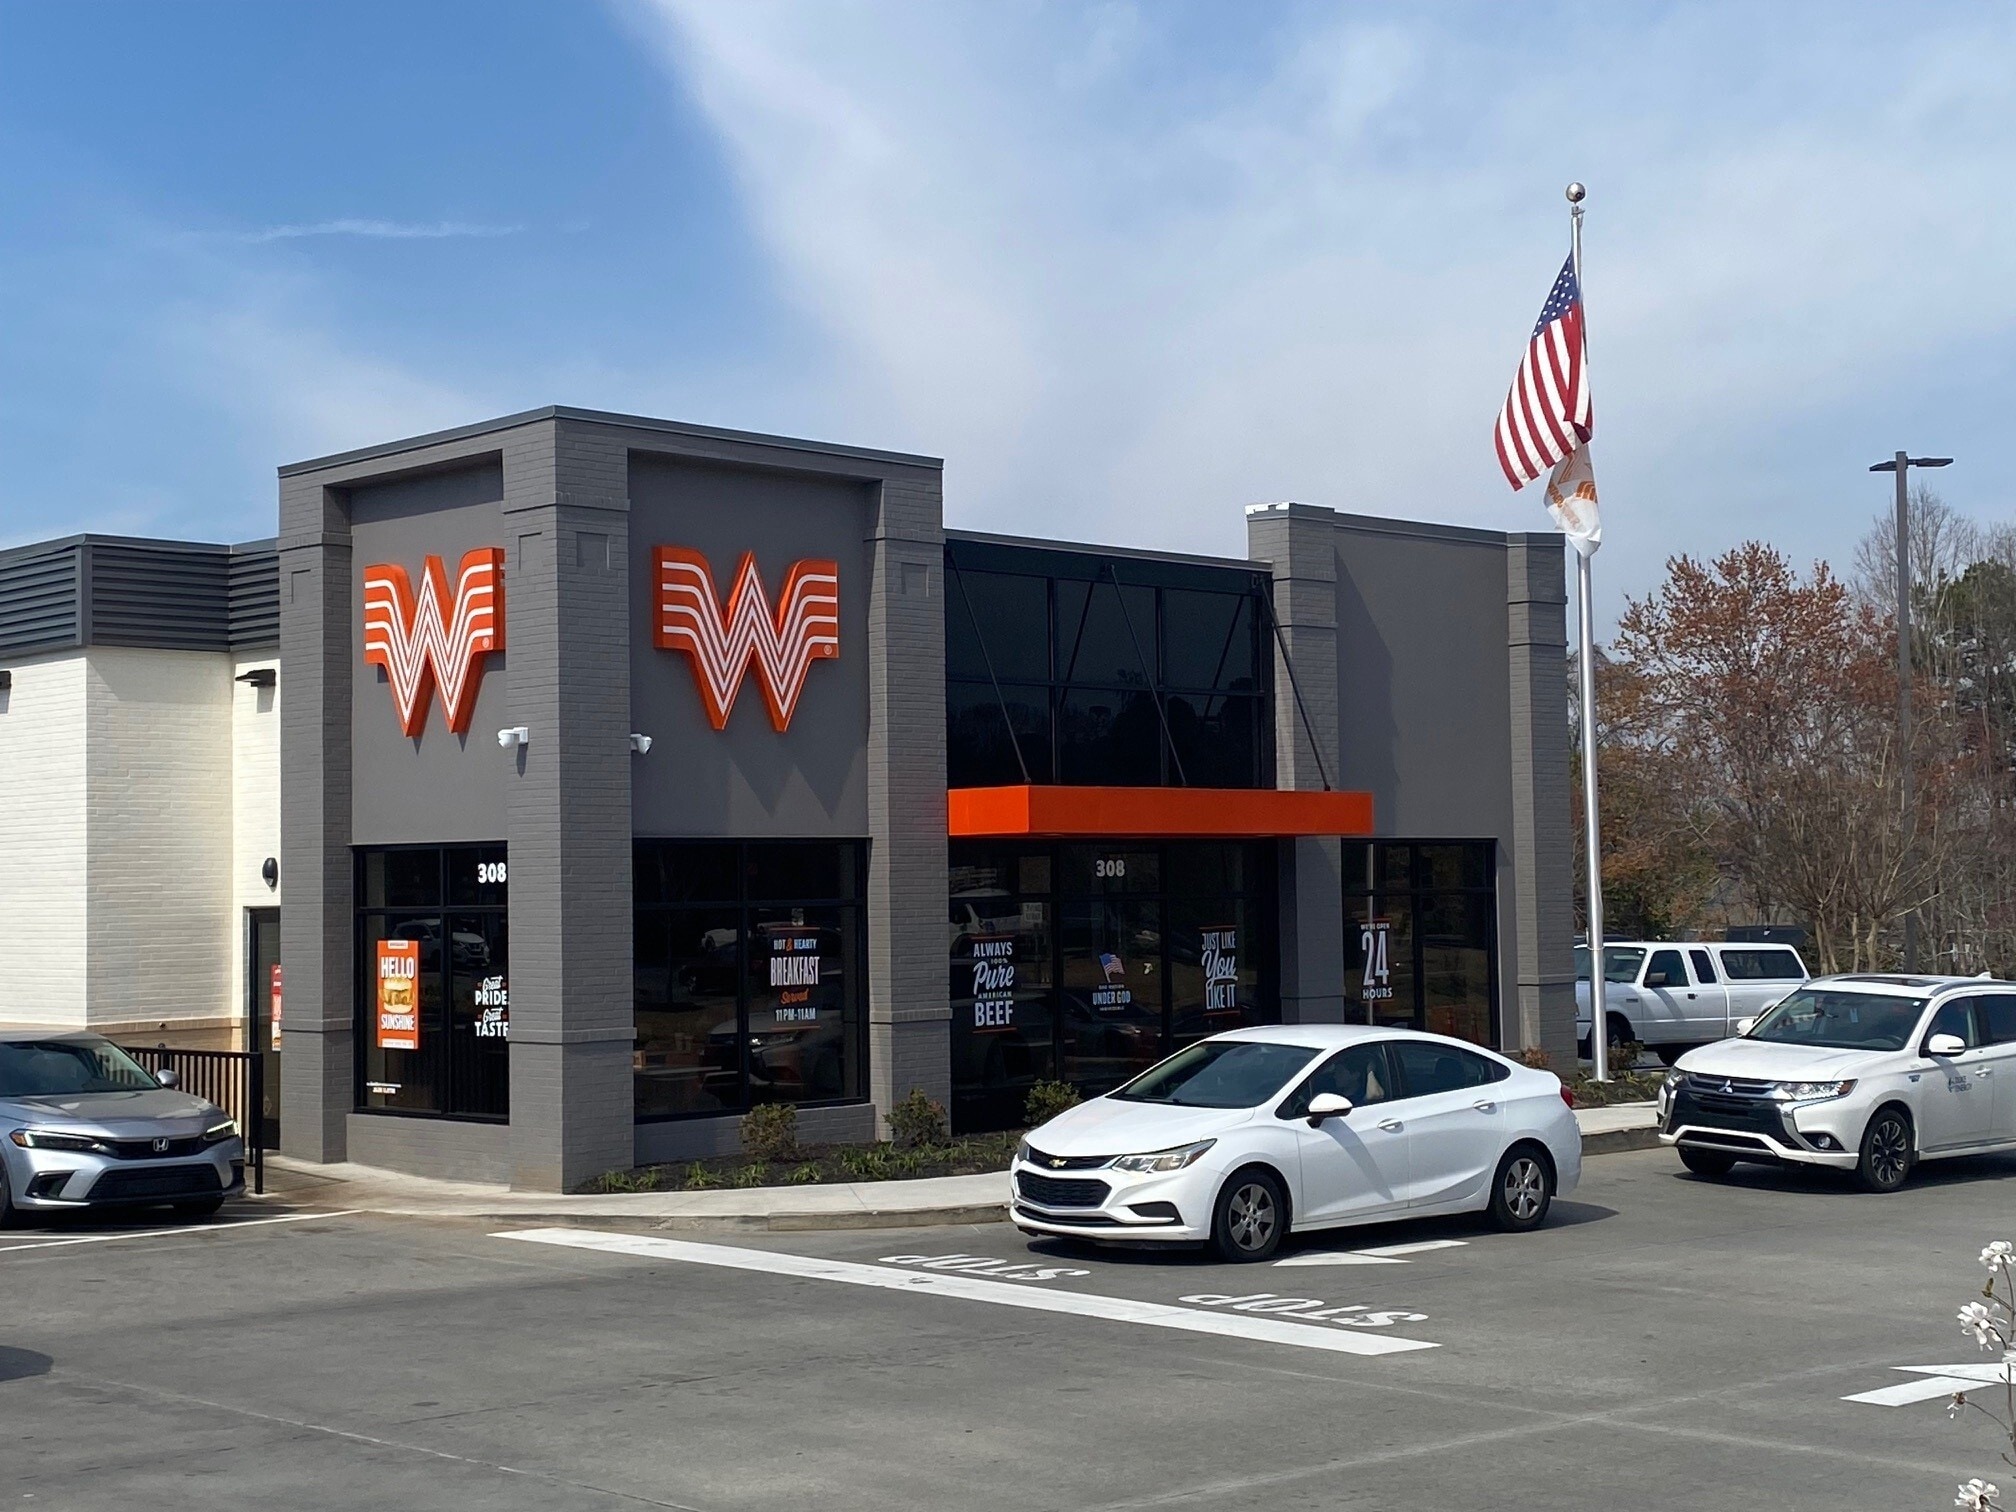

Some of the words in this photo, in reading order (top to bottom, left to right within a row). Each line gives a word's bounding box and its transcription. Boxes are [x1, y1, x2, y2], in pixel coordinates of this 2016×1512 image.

[365, 547, 505, 737] W
[654, 546, 839, 732] W
[477, 862, 507, 884] 308
[1096, 860, 1125, 877] 308
[973, 941, 1013, 958] ALWAYS
[1201, 932, 1219, 951] JUST
[1221, 930, 1236, 950] LIKE
[380, 956, 415, 979] HELLO
[1201, 948, 1239, 986] You
[1362, 930, 1390, 986] 24
[770, 957, 820, 987] BREAKFAST
[972, 960, 1015, 996] Pure
[1092, 991, 1116, 1006] UNDER
[1116, 990, 1131, 1004] GOD
[1205, 984, 1226, 1010] LIKE
[1226, 983, 1236, 1008] IT
[1362, 987, 1393, 1000] HOURS
[381, 1013, 415, 1031] SUNSHINE
[974, 1000, 1014, 1027] BEEF
[1178, 1293, 1430, 1327] STOP
